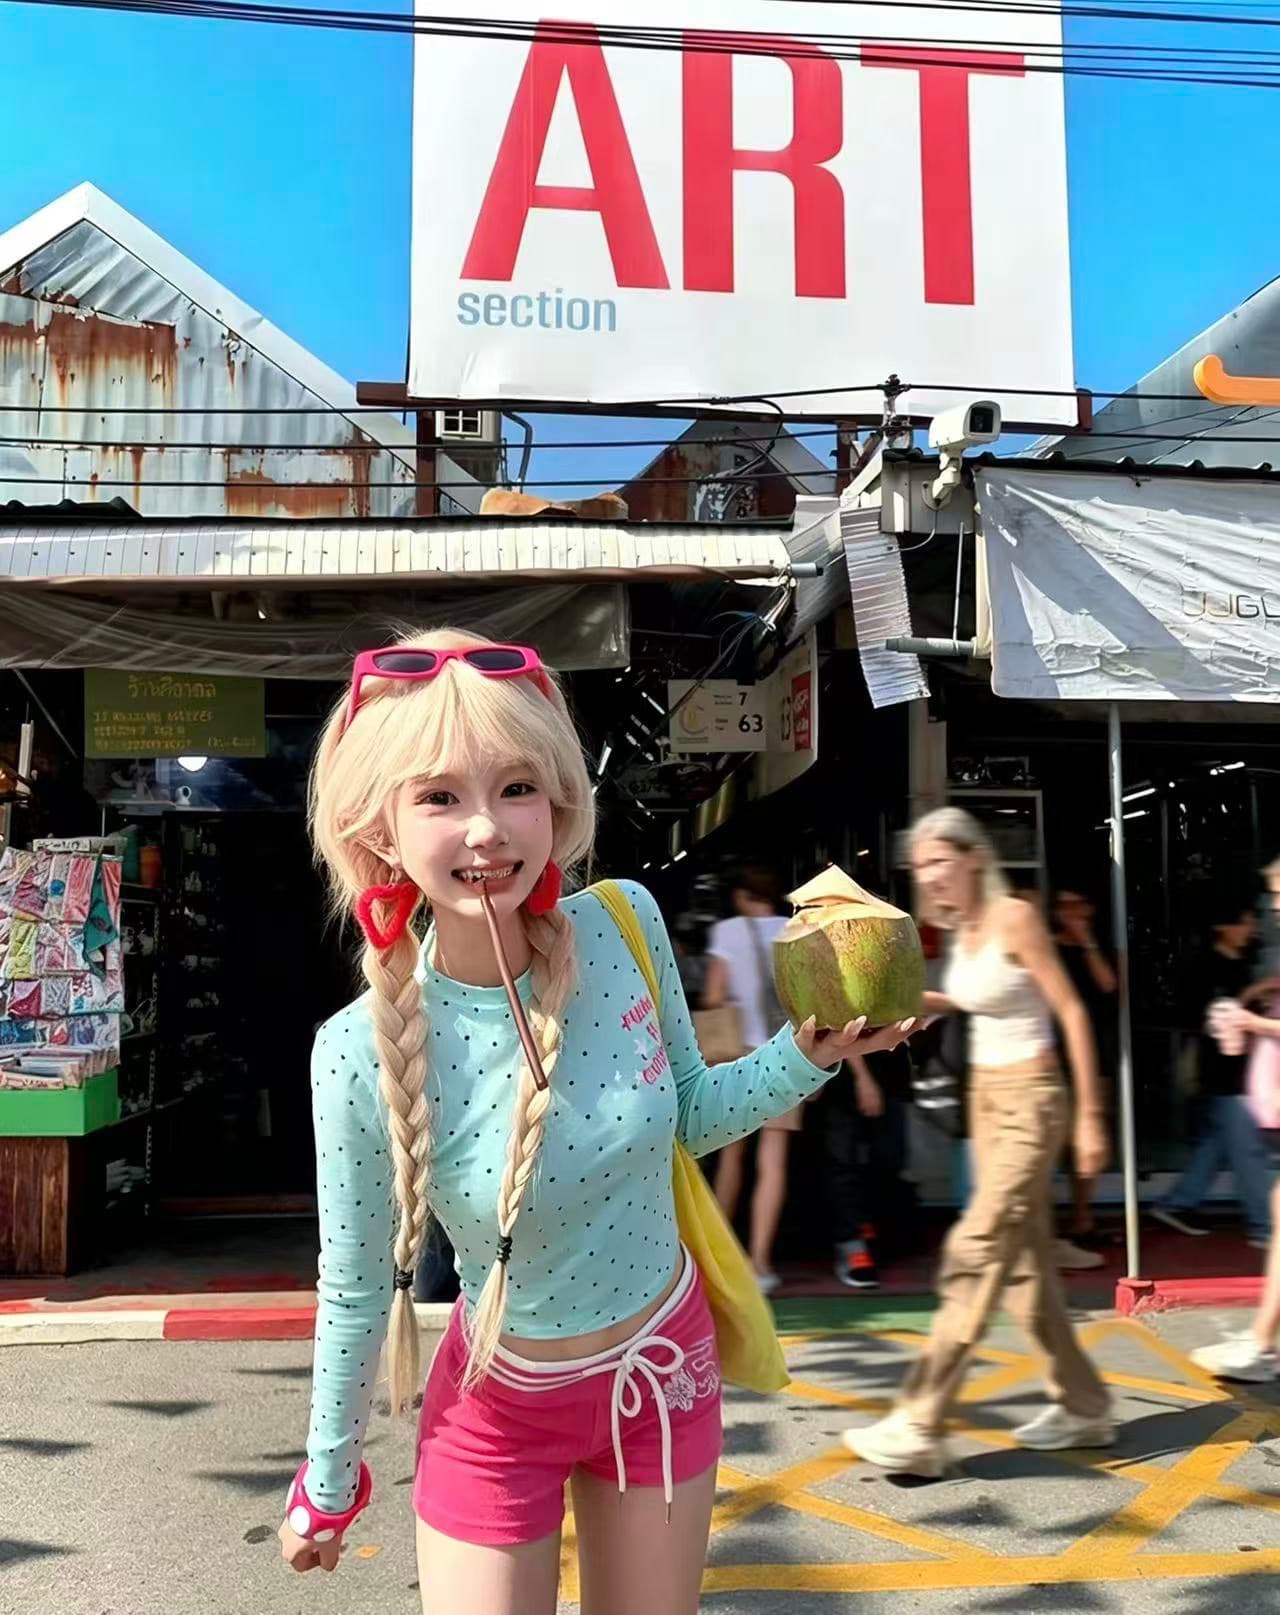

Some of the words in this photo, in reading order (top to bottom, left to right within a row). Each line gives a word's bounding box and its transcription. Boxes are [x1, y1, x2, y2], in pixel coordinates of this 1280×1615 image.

[459, 18, 1025, 306] ART
[457, 288, 617, 332] section
[738, 692, 748, 706] 7
[738, 714, 764, 733] 63
